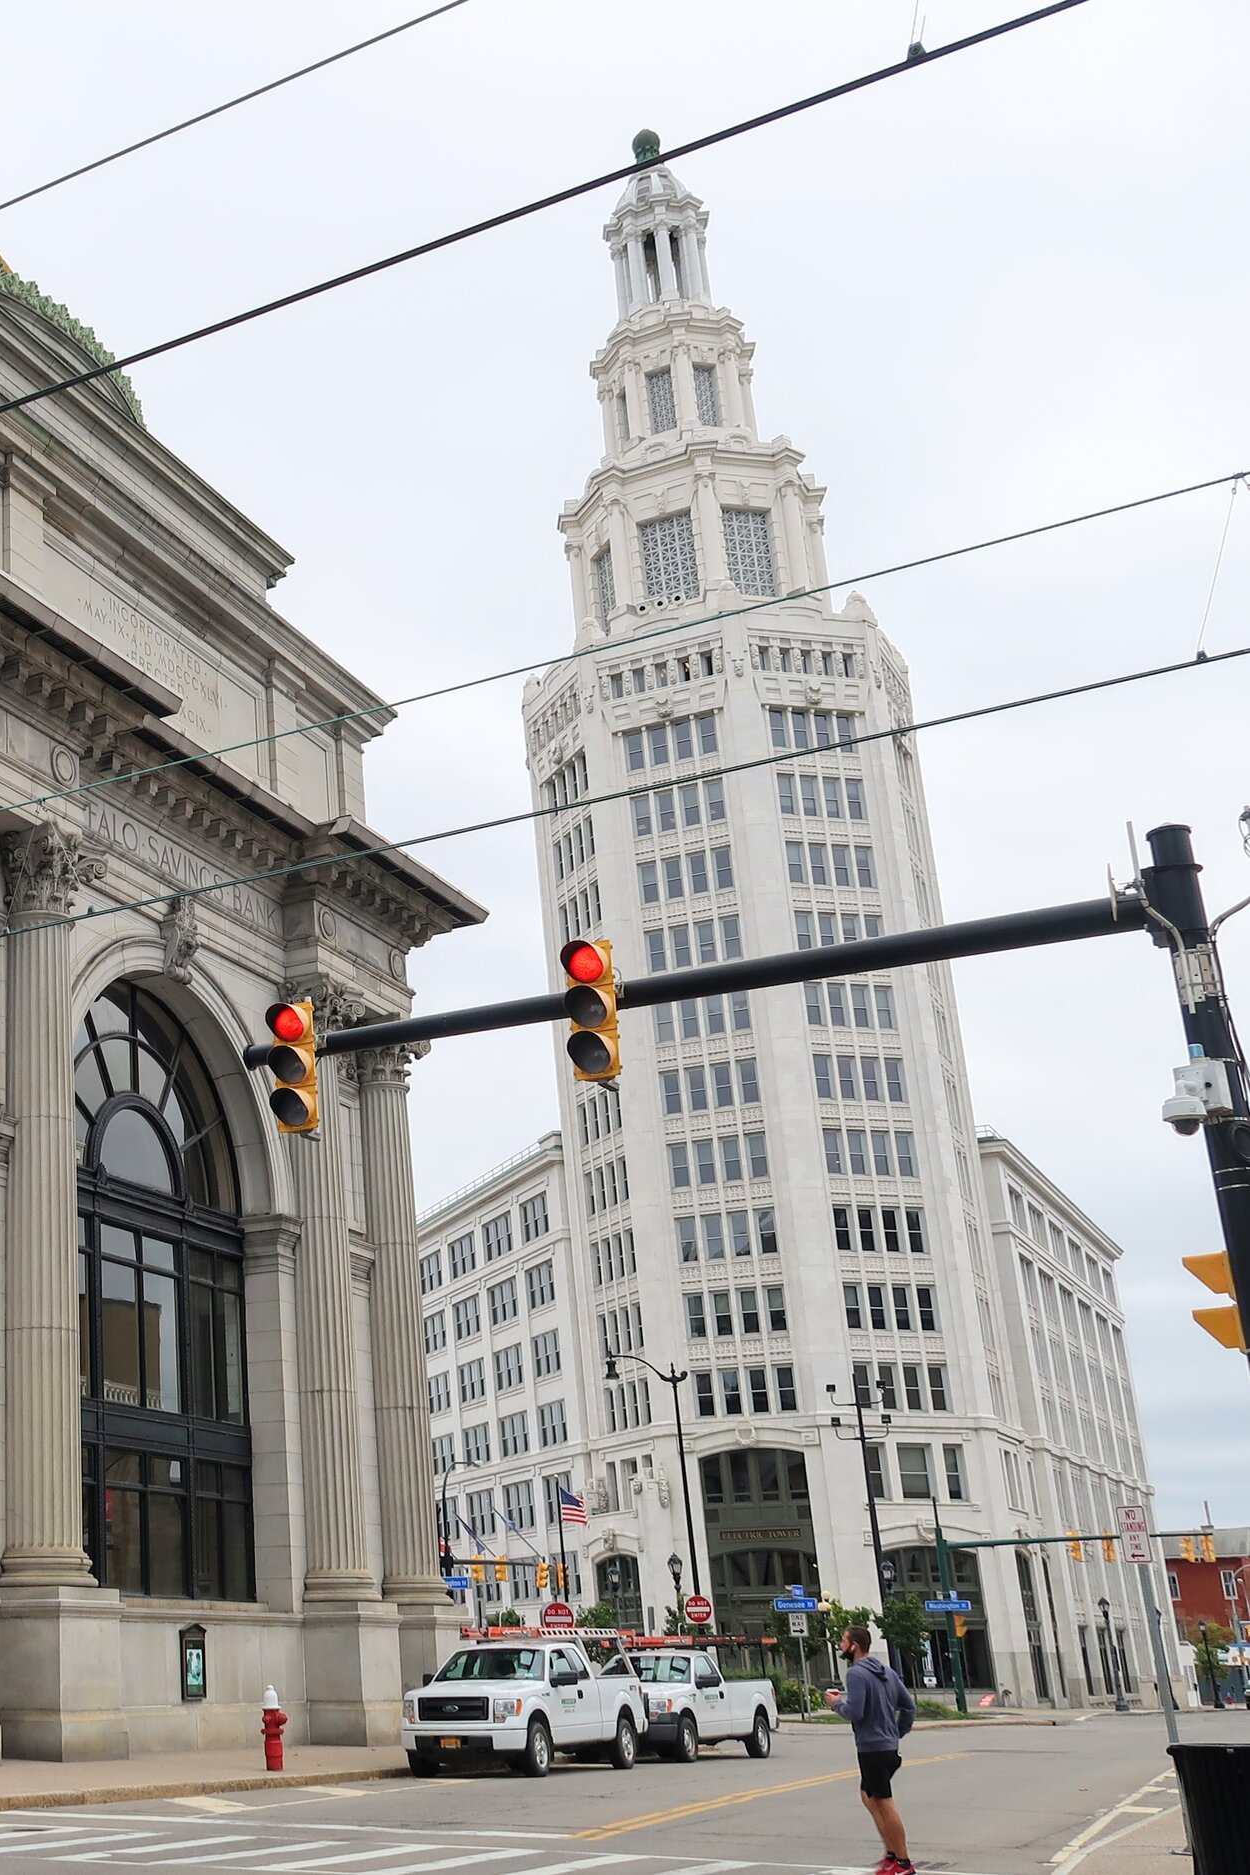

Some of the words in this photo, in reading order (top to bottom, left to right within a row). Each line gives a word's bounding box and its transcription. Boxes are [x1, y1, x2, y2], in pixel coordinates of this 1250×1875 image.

[109, 597, 201, 675] INCORPORATED
[148, 835, 224, 901] SAVINGS
[232, 884, 279, 932] BANK
[1124, 1510, 1136, 1520] NO
[721, 1531, 764, 1539] ELECTRIC
[769, 1529, 800, 1538] TOWER
[777, 1601, 805, 1609] Genesee
